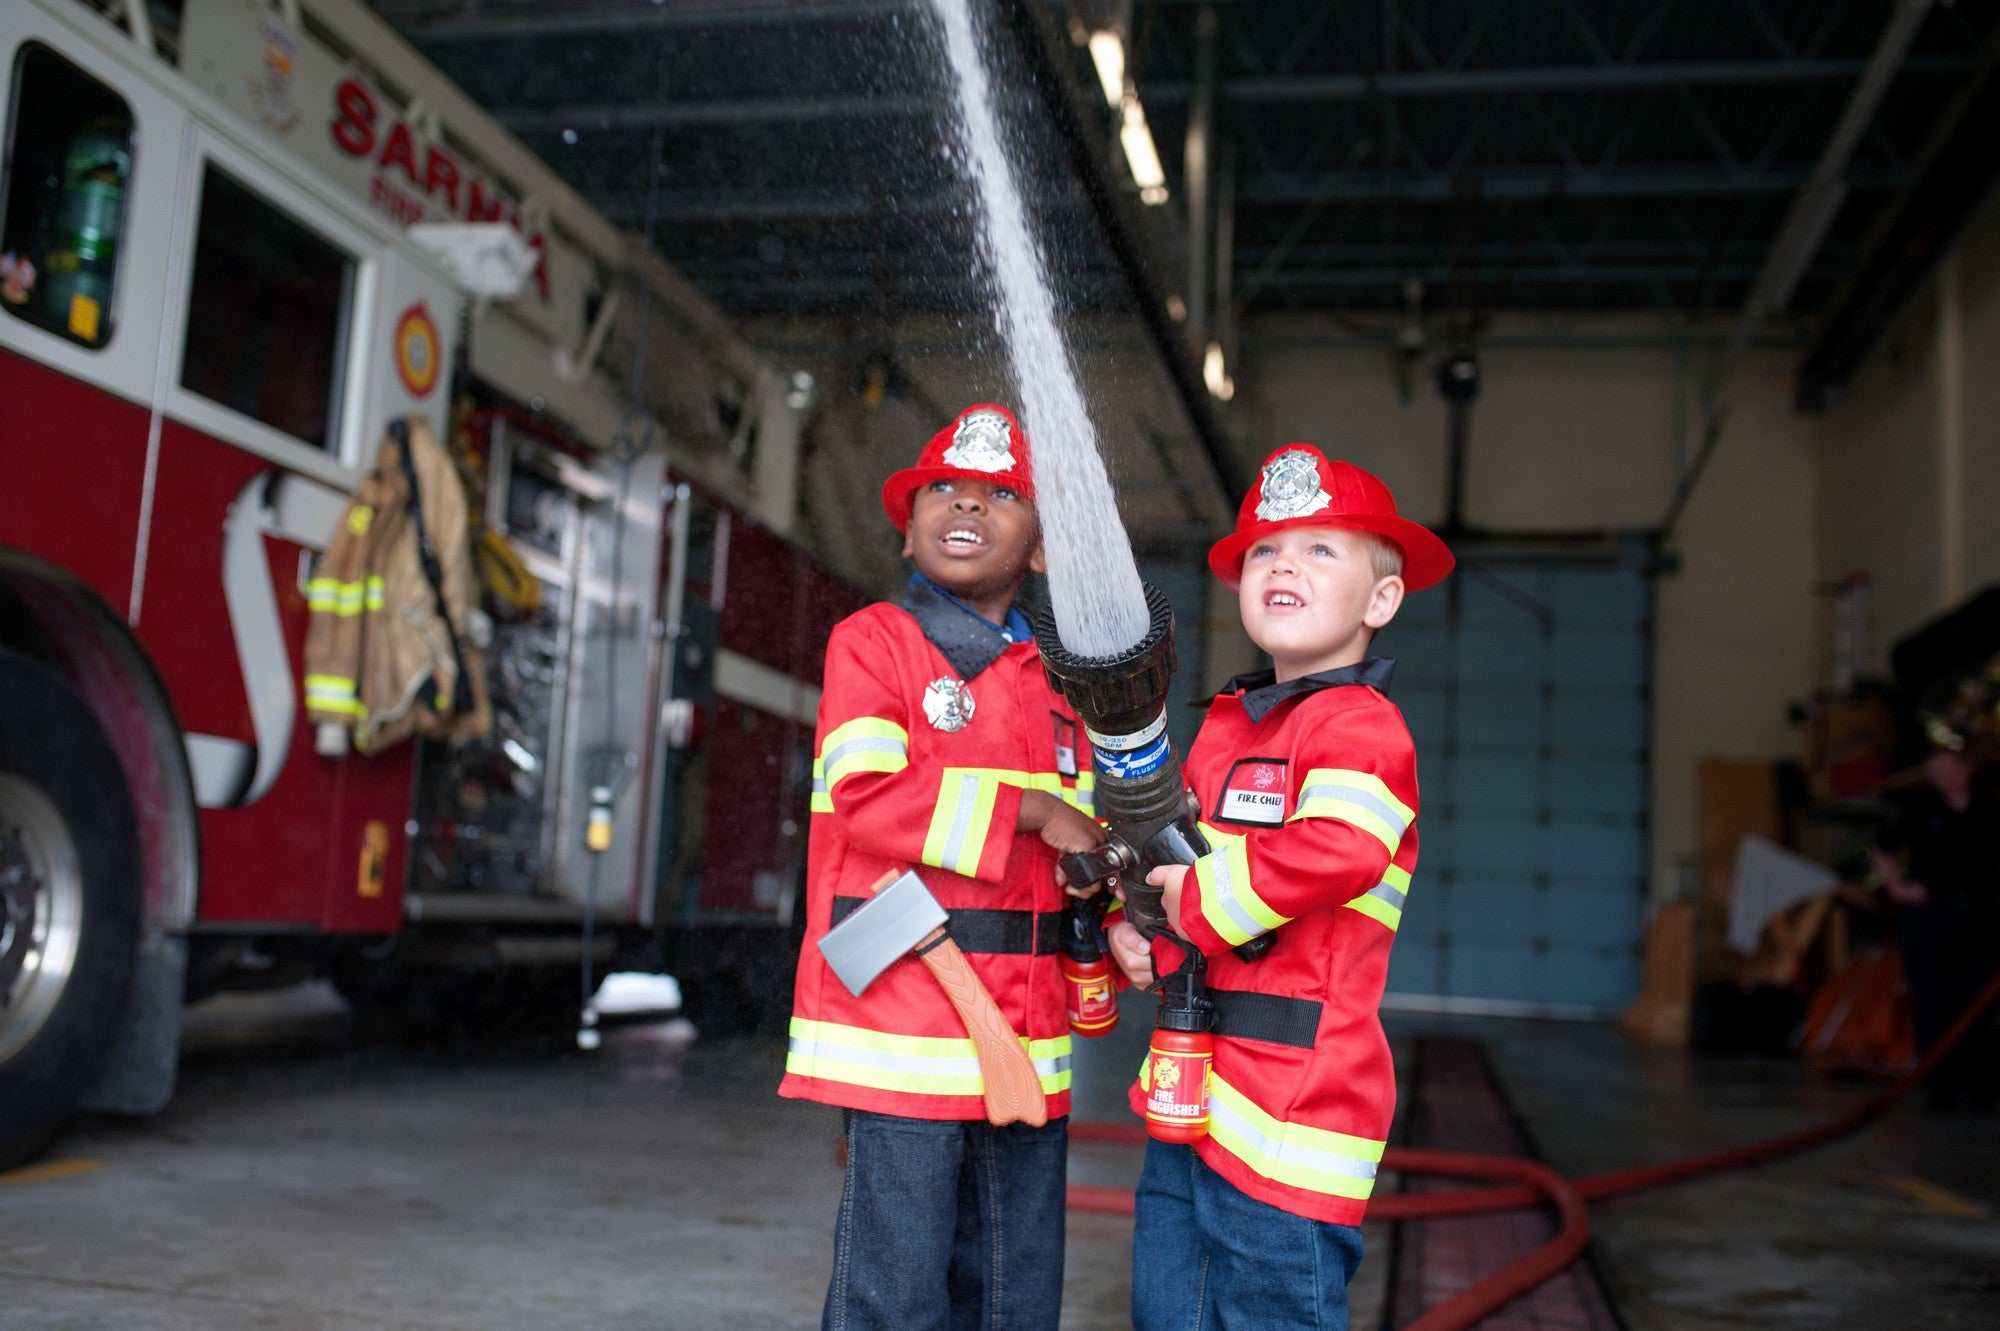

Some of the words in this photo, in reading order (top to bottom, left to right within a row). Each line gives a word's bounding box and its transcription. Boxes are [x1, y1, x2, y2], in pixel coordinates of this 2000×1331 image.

[1131, 762, 1156, 776] FLUSH
[1238, 793, 1257, 803] FIRE
[1155, 1089, 1175, 1103] FIRE
